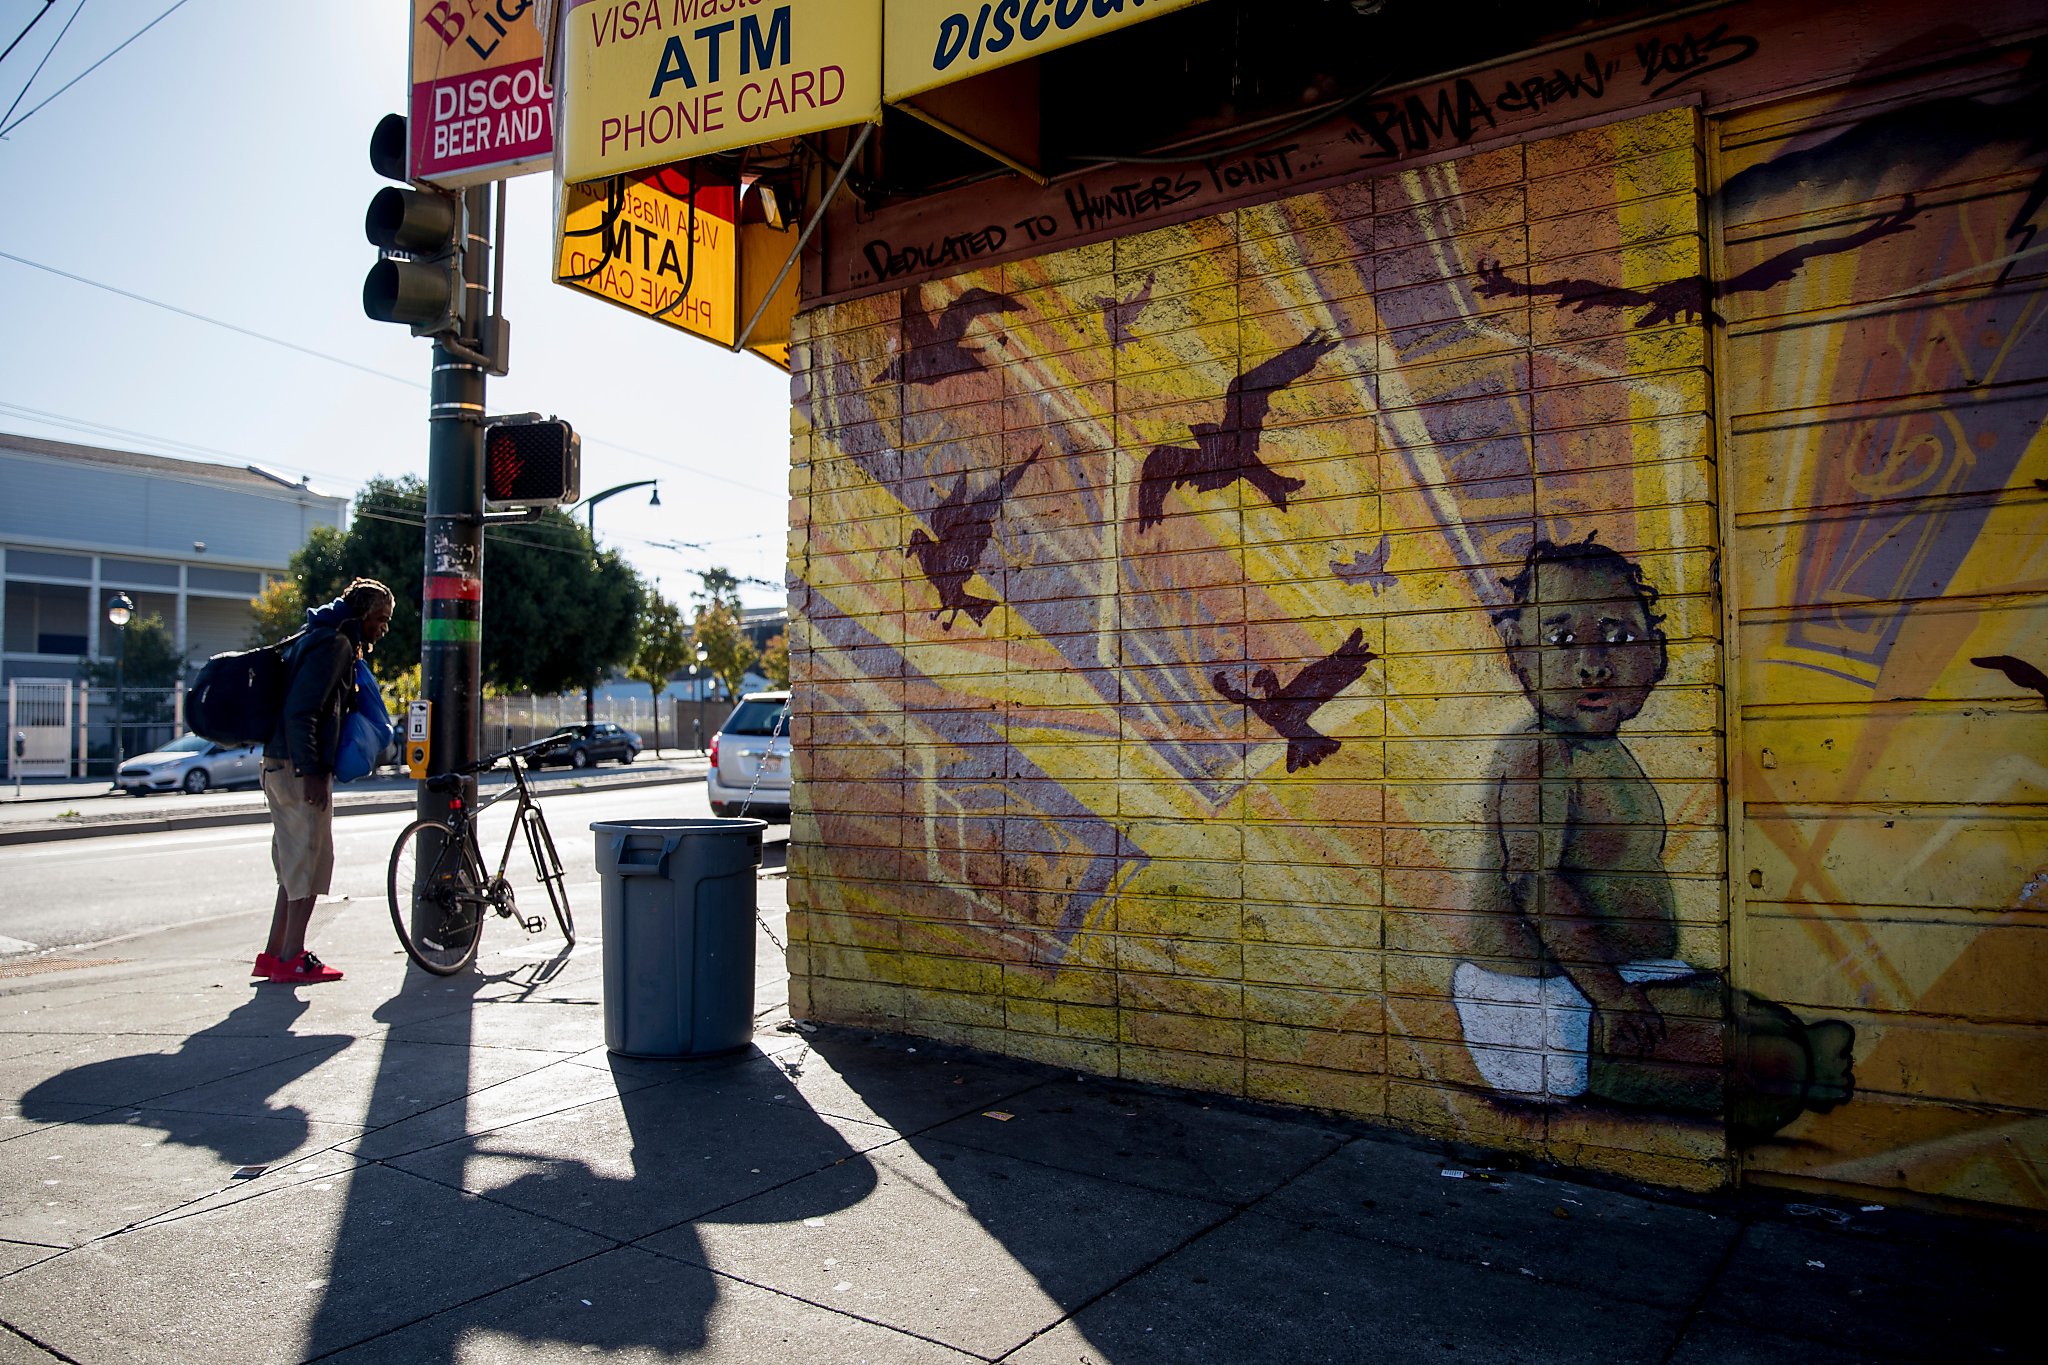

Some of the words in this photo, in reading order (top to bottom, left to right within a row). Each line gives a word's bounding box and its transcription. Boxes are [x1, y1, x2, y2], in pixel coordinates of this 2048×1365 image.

[592, 0, 662, 48] VISA
[649, 4, 792, 99] ATM
[434, 116, 491, 160] BEER
[494, 106, 543, 148] AND
[601, 90, 724, 157] PHONE
[737, 64, 845, 123] CARD
[1014, 215, 1057, 241] TO
[1065, 170, 1202, 230] HUNTERS
